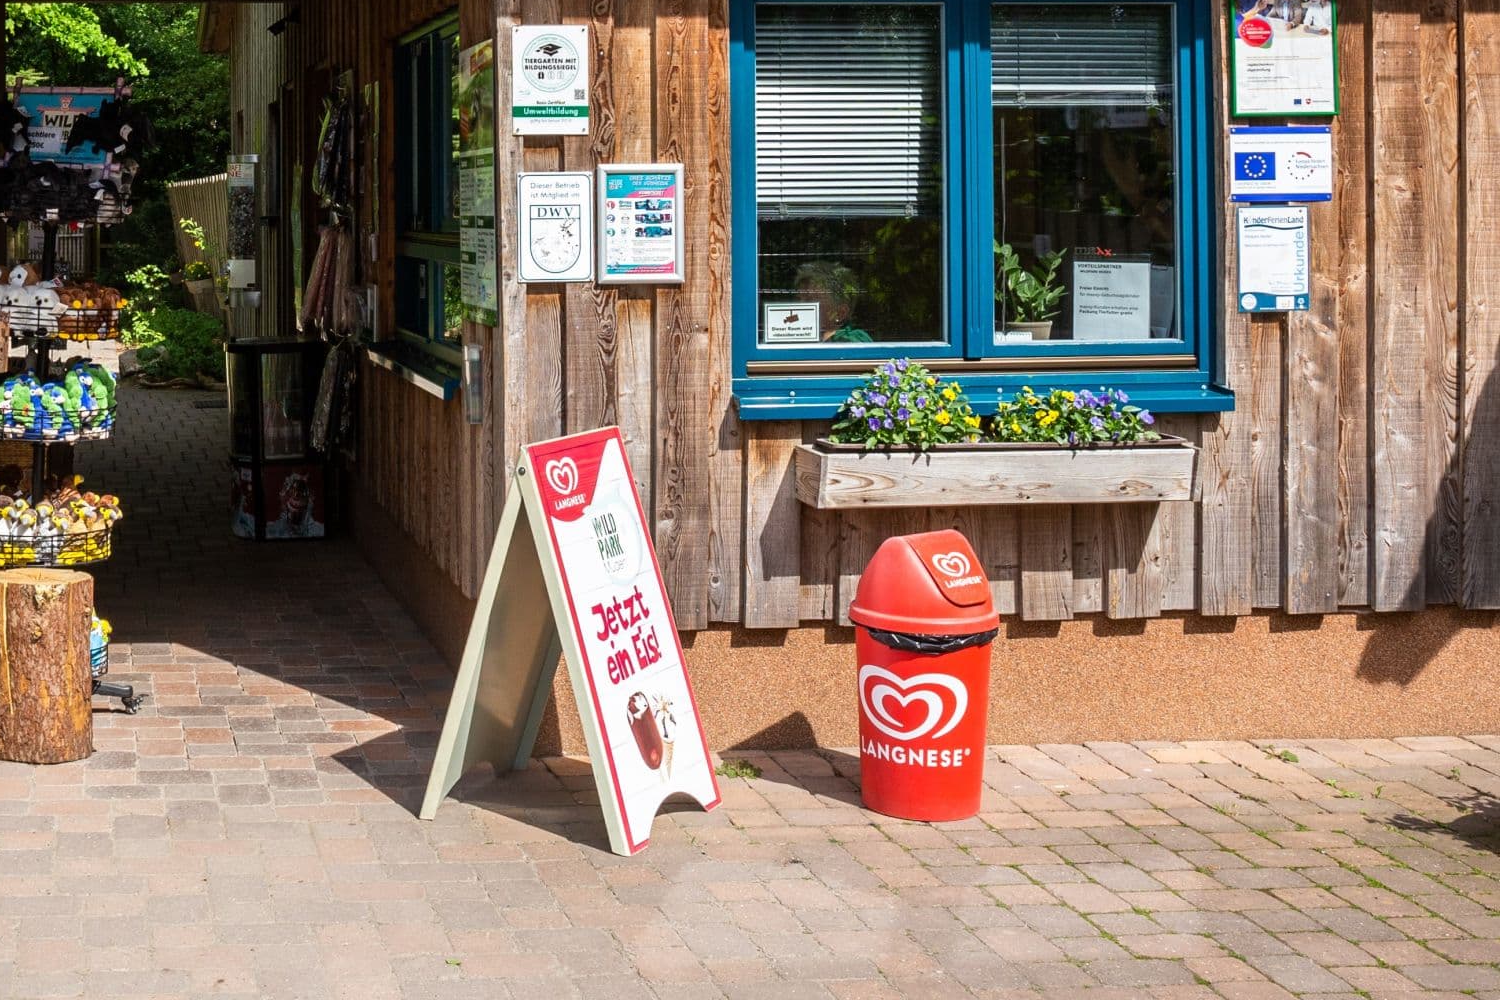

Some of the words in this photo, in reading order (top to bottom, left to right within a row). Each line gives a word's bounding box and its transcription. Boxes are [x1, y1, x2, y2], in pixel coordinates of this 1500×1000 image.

[523, 107, 579, 116] Umweltbildung
[541, 192, 569, 200] Mitglied
[537, 207, 573, 217] DWV
[1293, 231, 1305, 292] Urkunde
[592, 512, 617, 538] WILD
[597, 534, 624, 560] PARK
[591, 585, 650, 641] Jetzt
[607, 640, 636, 685] ein
[631, 625, 662, 670] Eis!
